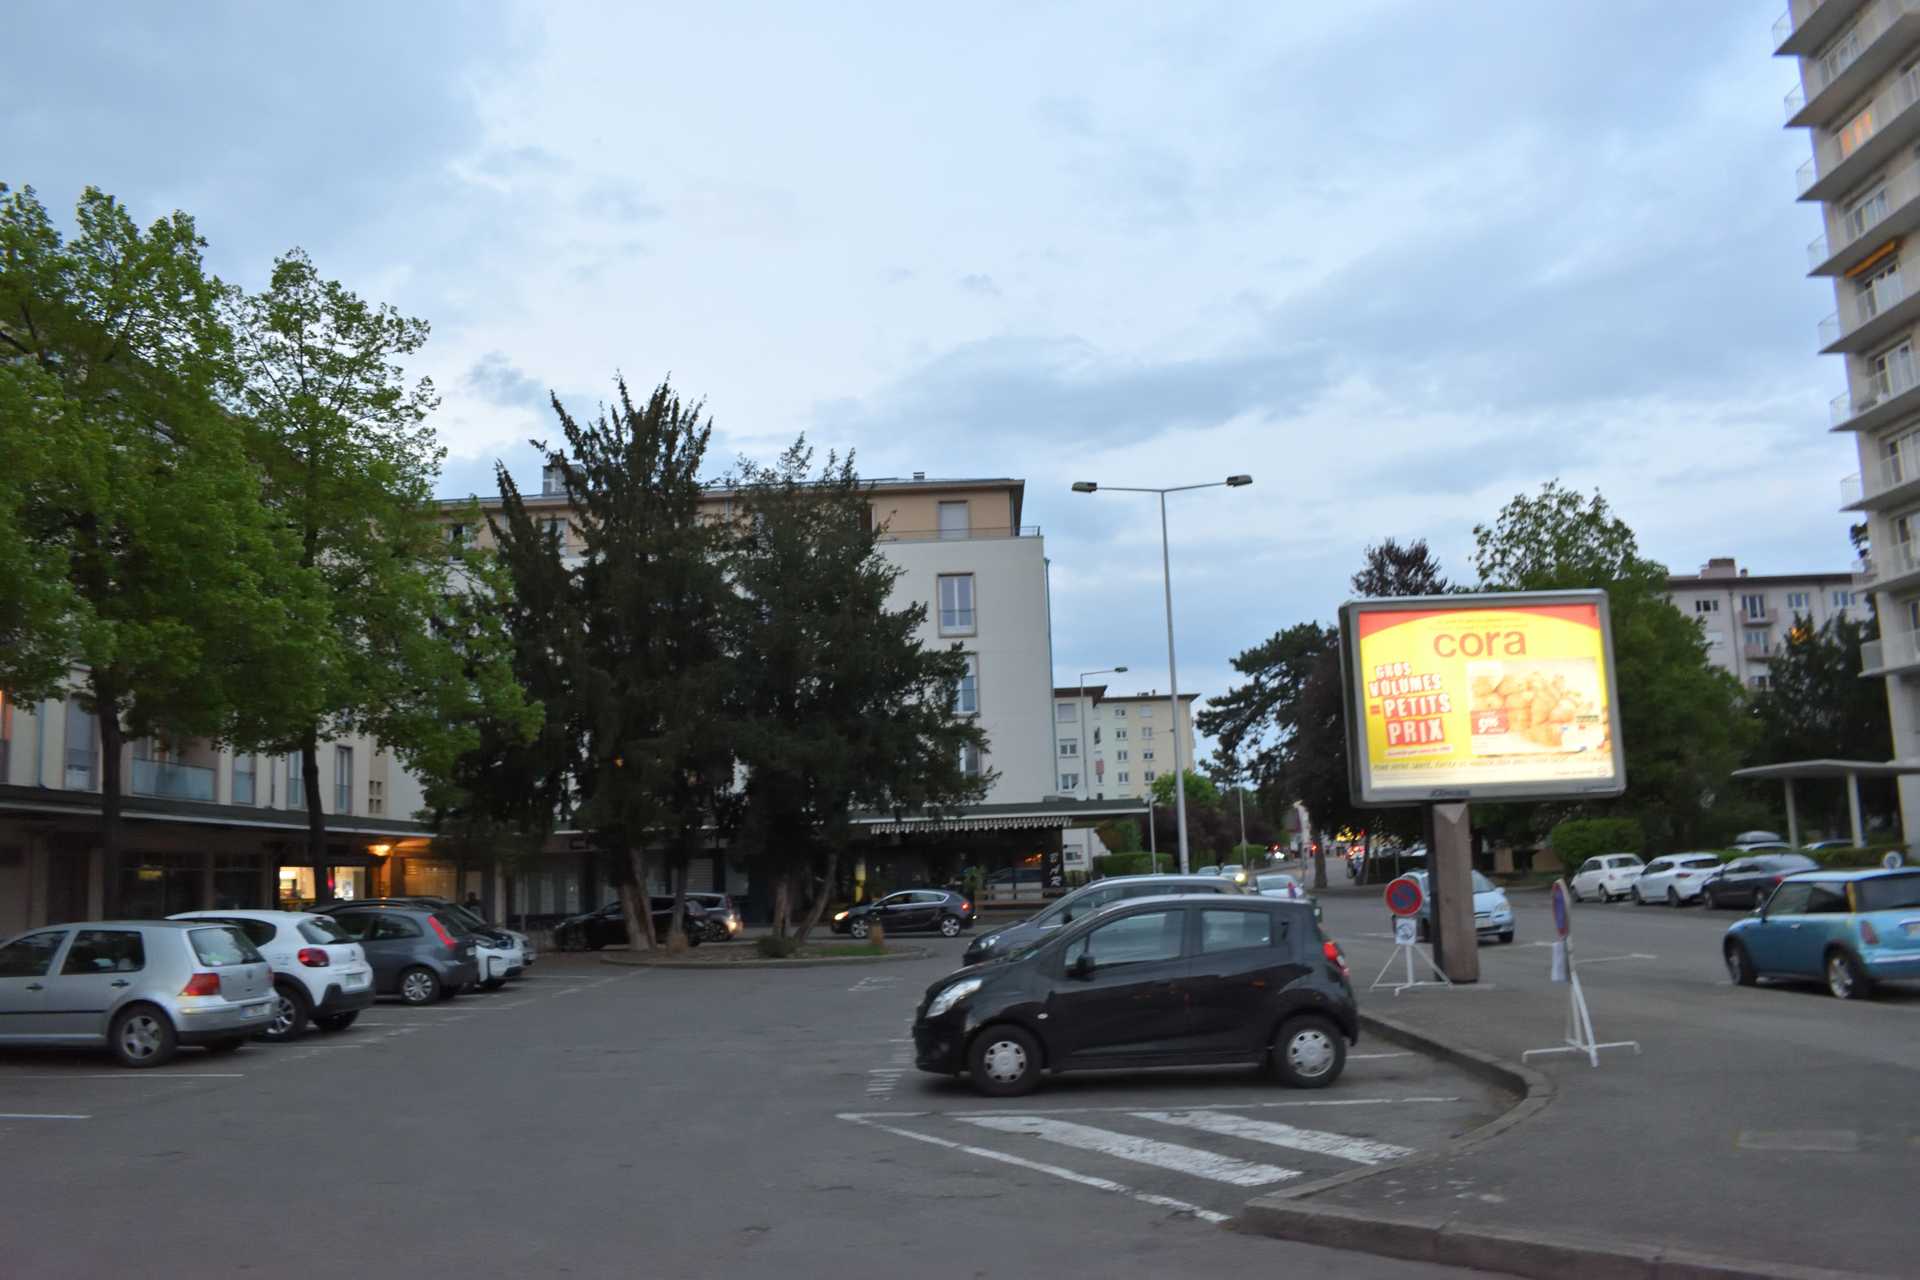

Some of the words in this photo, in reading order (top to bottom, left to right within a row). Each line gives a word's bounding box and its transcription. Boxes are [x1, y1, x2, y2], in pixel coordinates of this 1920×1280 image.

[1433, 631, 1526, 657] cora
[1375, 662, 1412, 679] GROS
[1369, 674, 1441, 697] VOLUMES
[1384, 693, 1452, 717] PETITS
[1387, 719, 1444, 745] PRIX
